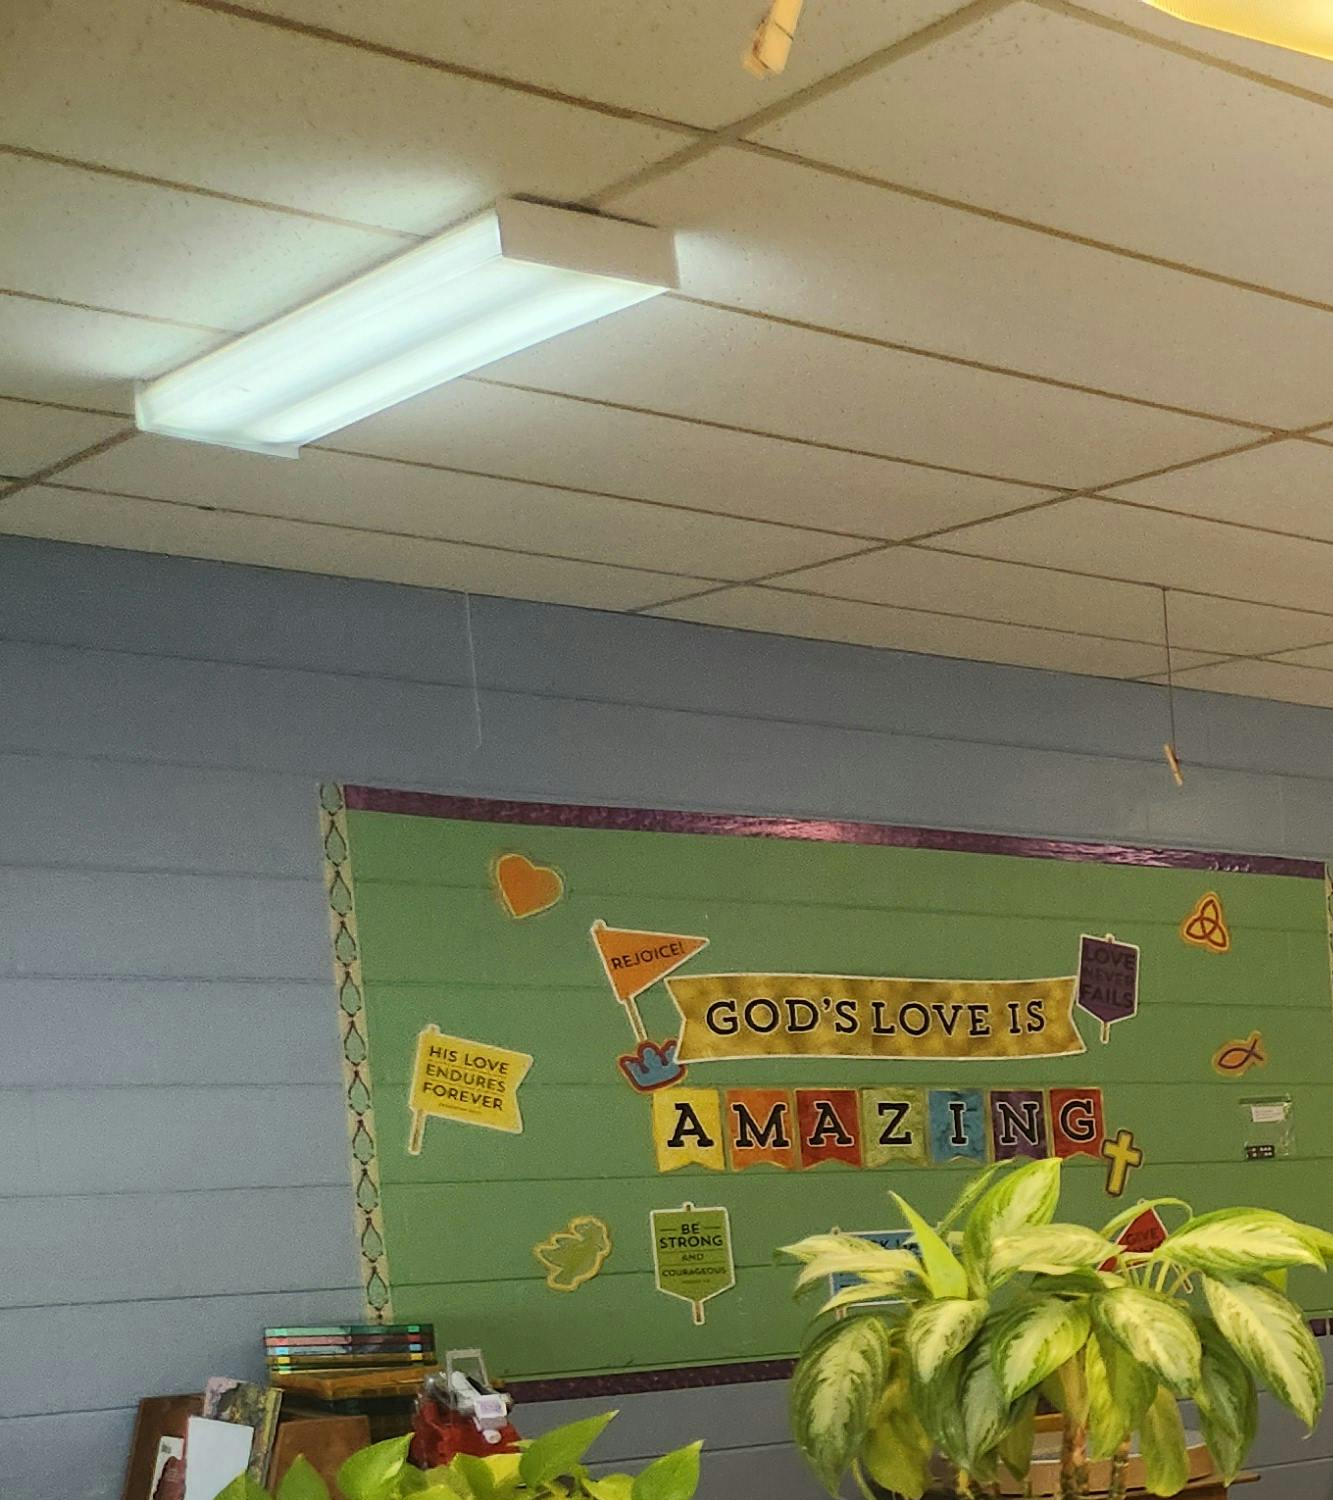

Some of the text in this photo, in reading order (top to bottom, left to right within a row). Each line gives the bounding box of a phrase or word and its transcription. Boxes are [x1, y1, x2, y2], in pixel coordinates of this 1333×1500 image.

[611, 941, 685, 971] REJOICE!
[1084, 947, 1135, 971] LOVE
[1081, 984, 1133, 1008] FAILS
[705, 997, 1046, 1037] GOD'S LOVE IS
[429, 1045, 510, 1075] HIS LOVE
[425, 1063, 506, 1093] ENDURES
[422, 1081, 504, 1111] FOREVER
[666, 1098, 1101, 1151] AMAZING
[659, 1235, 724, 1249] STRONG
[681, 1223, 700, 1235] BE
[681, 1253, 705, 1262] AND
[661, 1266, 727, 1277] COURAGEOUS
